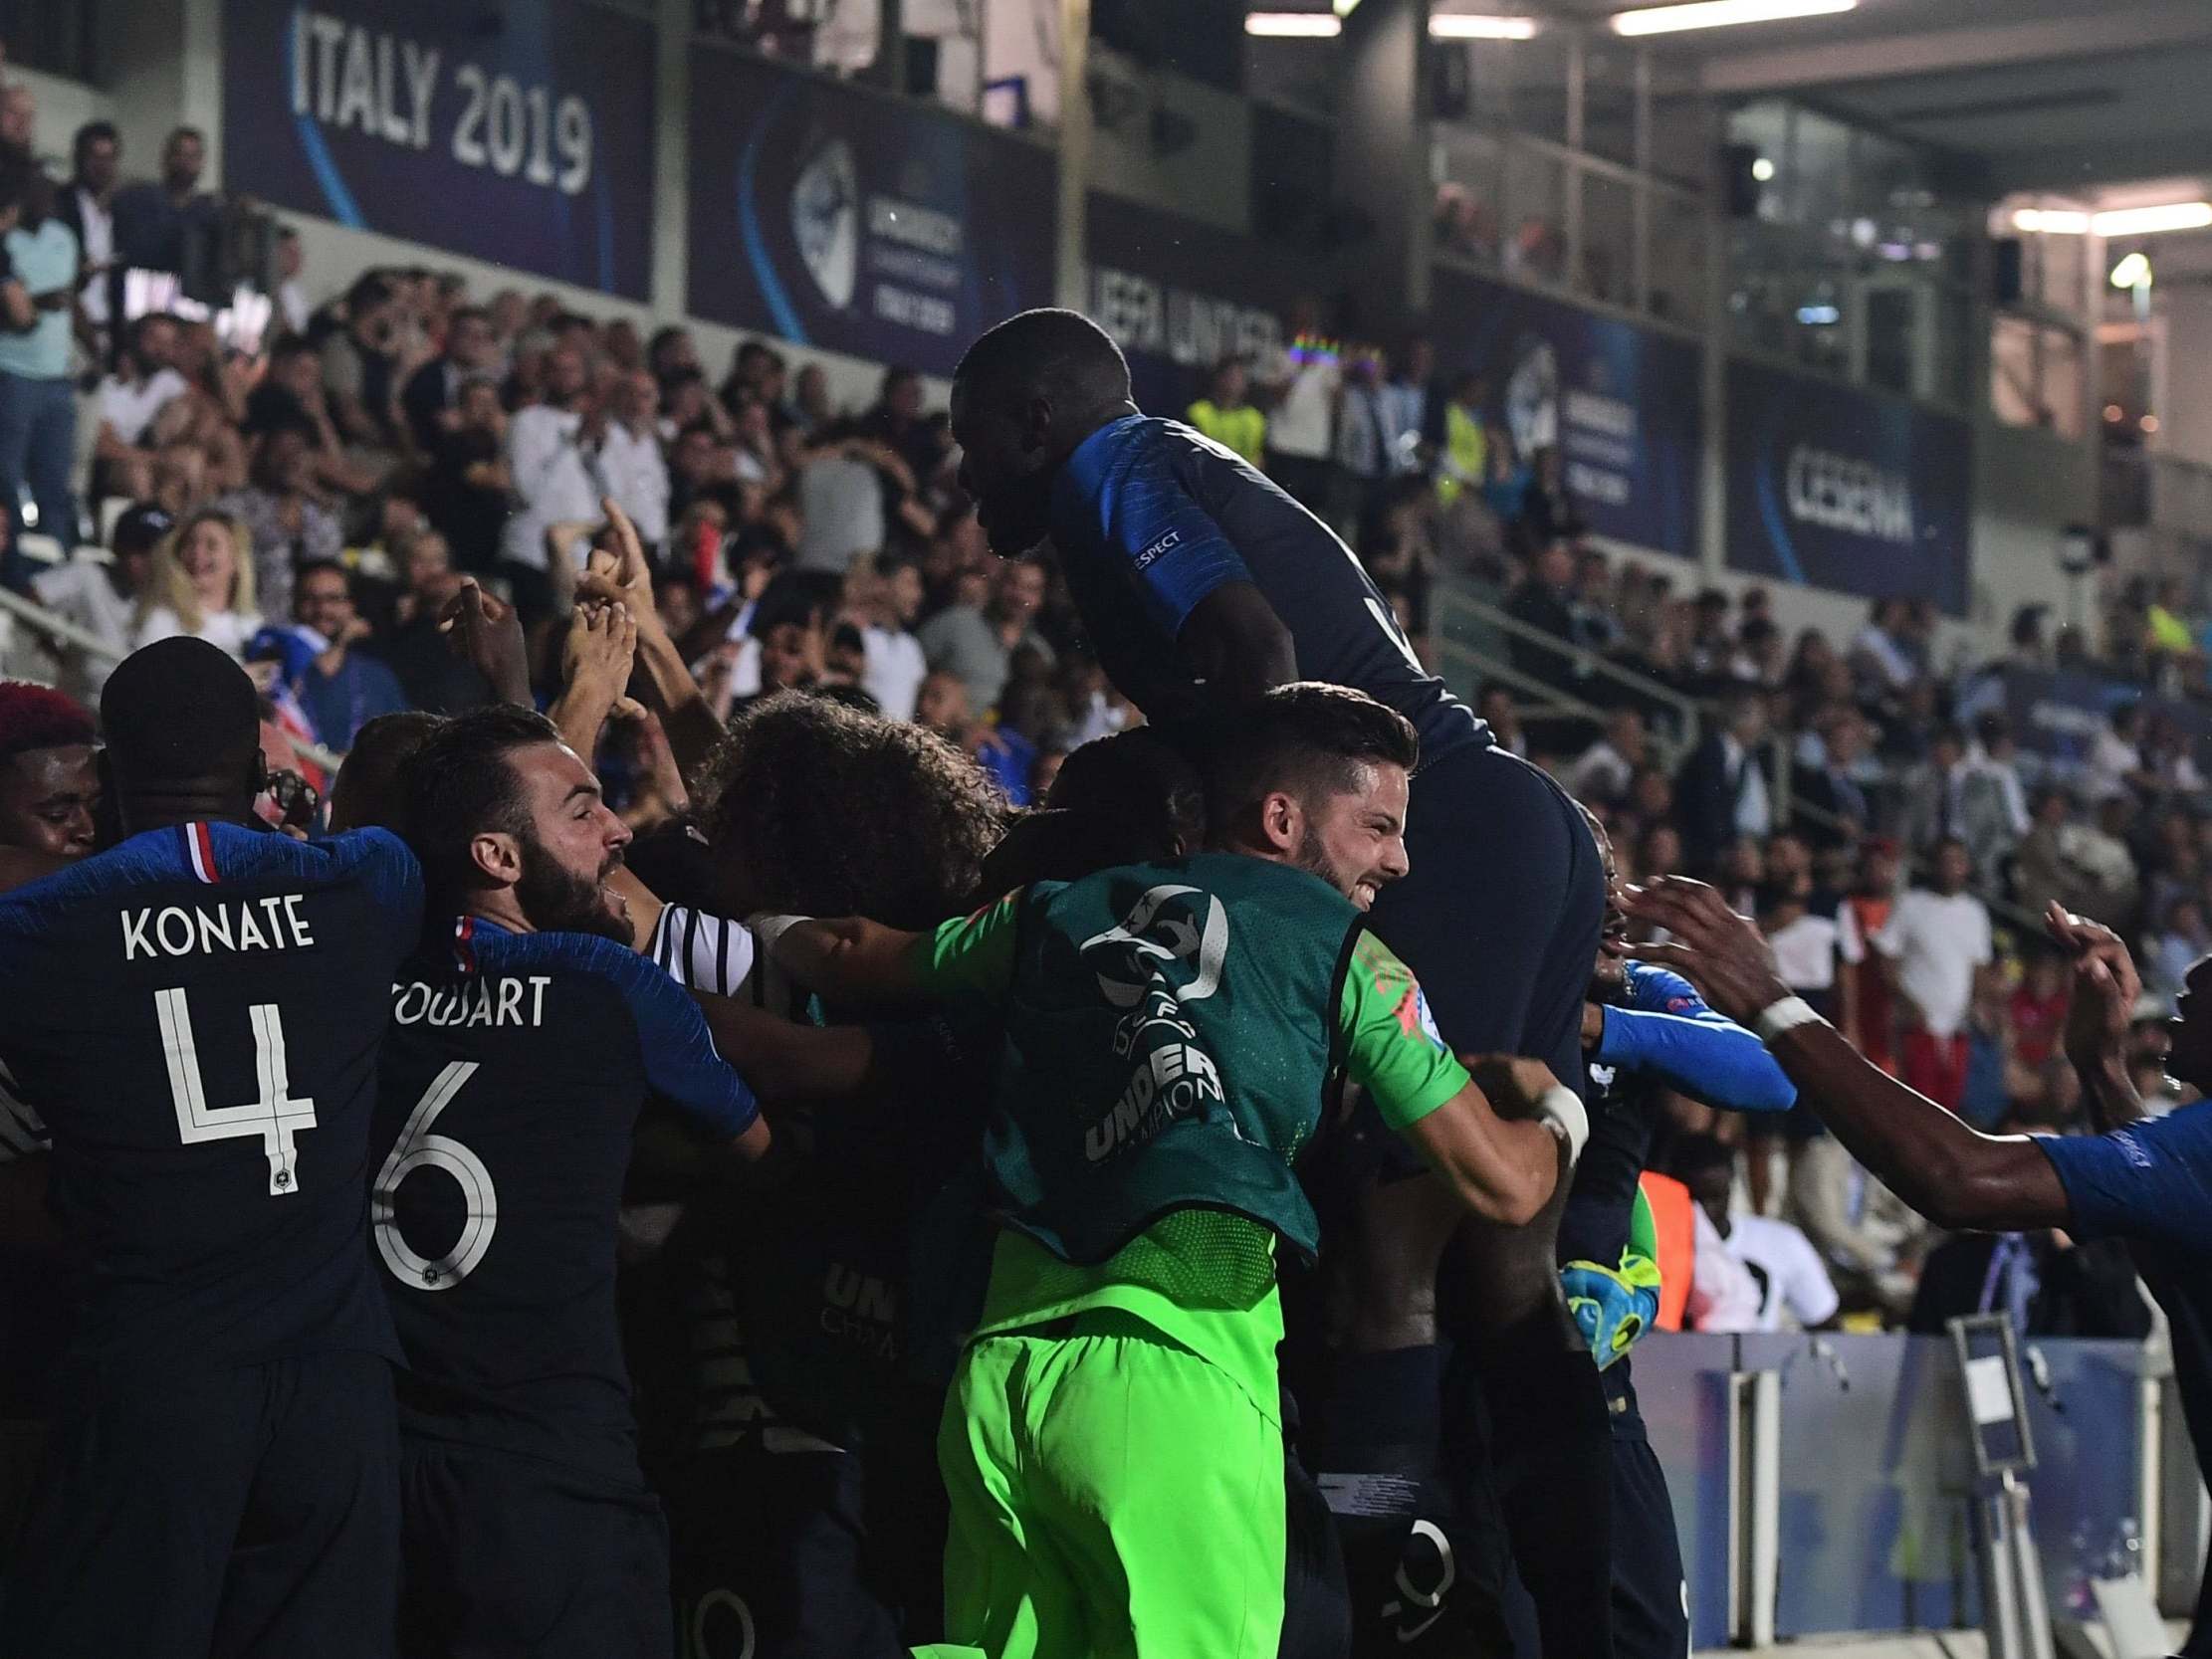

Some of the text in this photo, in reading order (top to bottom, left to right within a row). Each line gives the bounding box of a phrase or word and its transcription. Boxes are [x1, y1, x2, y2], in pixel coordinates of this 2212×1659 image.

[292, 9, 593, 197] ITALY 2019
[120, 893, 315, 960] KONATE
[154, 986, 318, 1196] 4
[371, 1060, 498, 1291] 6
[1085, 1042, 1221, 1162] UNDER
